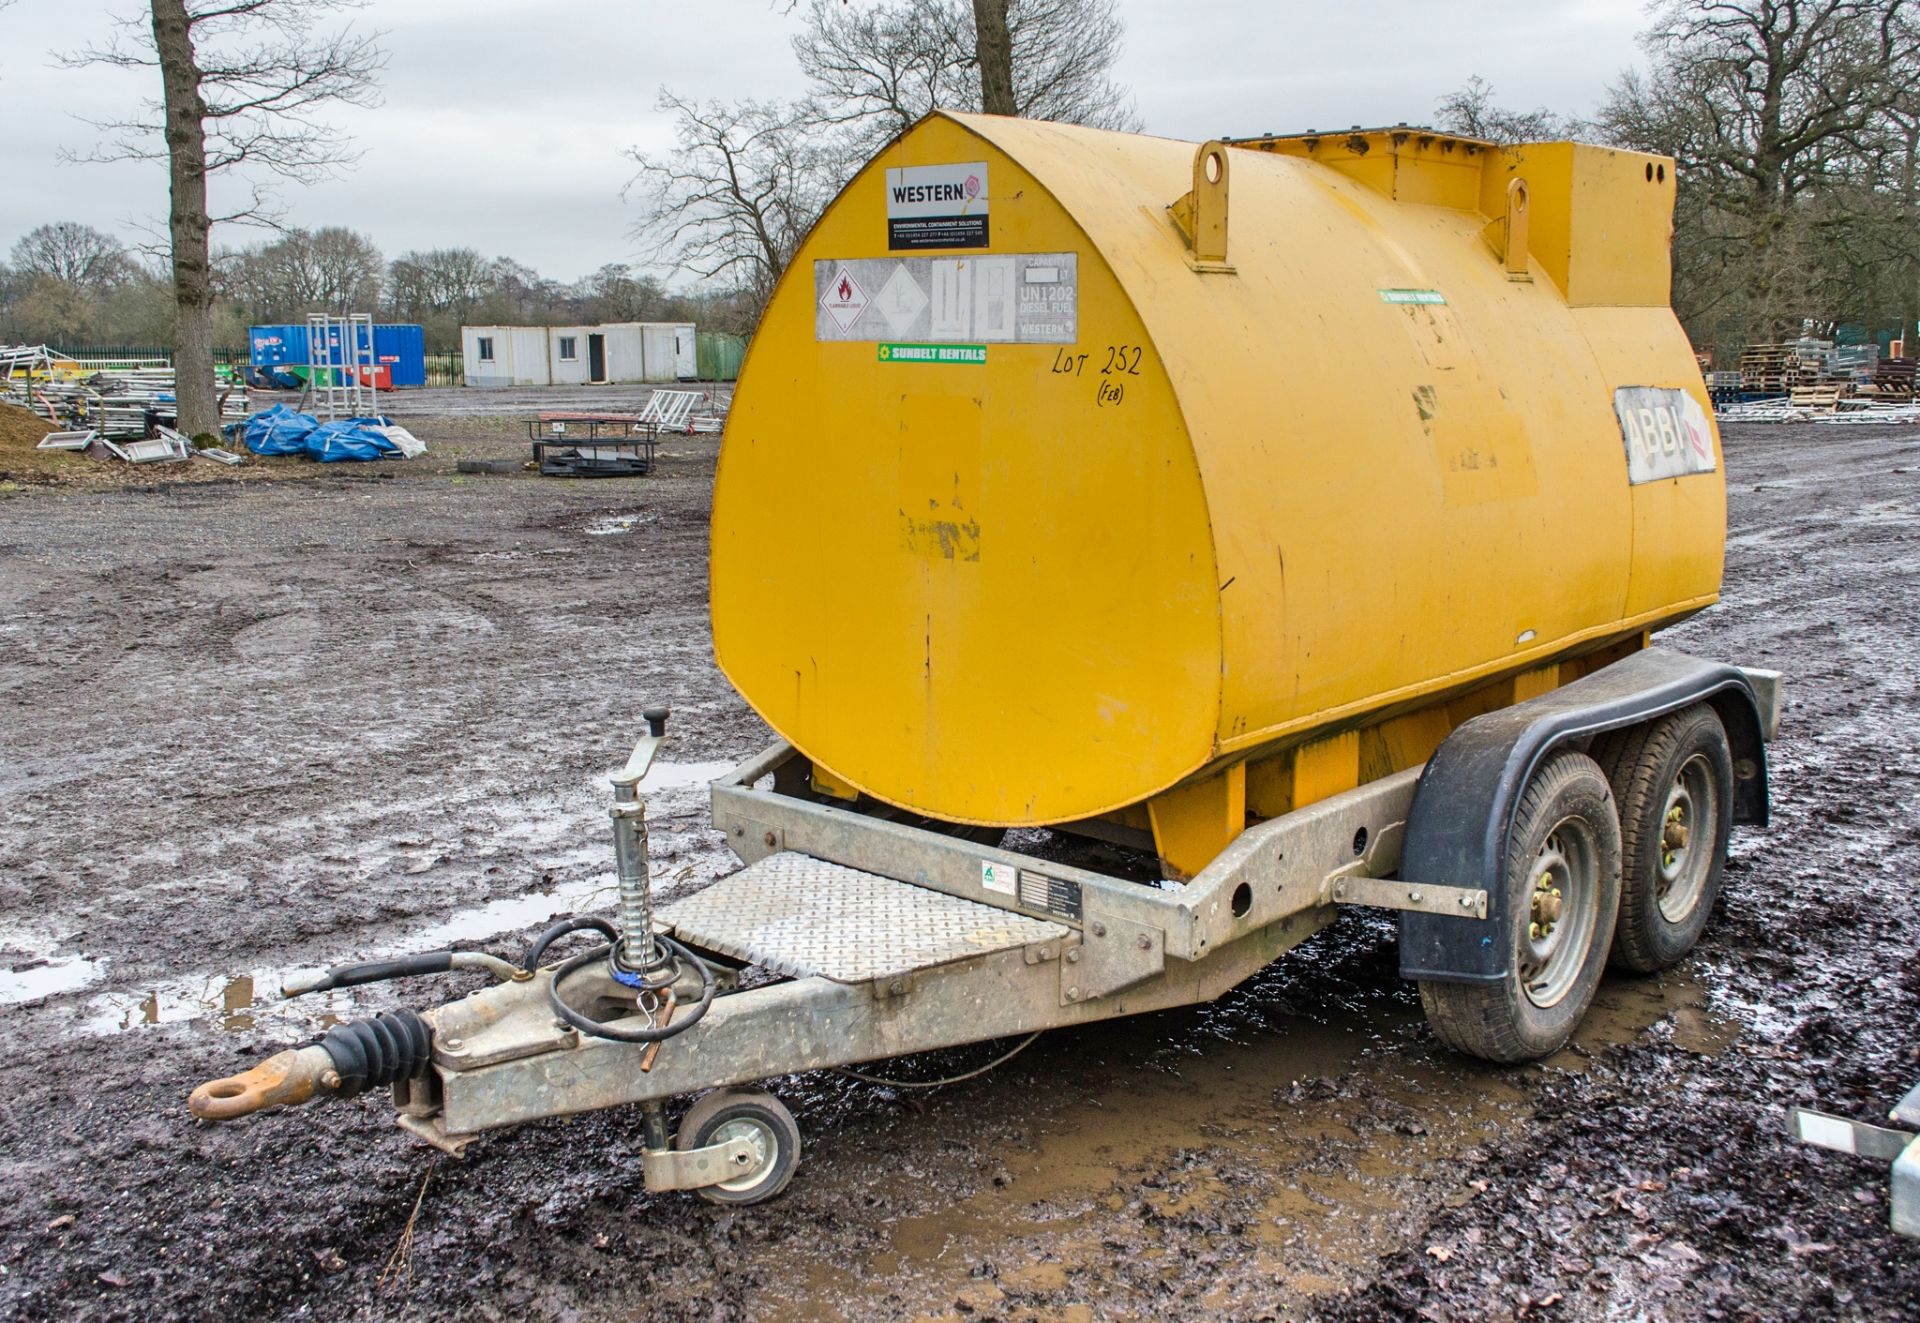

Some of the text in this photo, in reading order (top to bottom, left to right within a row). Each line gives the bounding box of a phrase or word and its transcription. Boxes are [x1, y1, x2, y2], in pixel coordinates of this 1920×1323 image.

[893, 184, 963, 203] WESTERN
[1028, 256, 1066, 267] CAPACITY
[1021, 286, 1074, 301] UN1202
[1021, 302, 1074, 313] DIESEL FUEL
[1021, 323, 1065, 335] WESTERN
[892, 347, 986, 361] SUNBELT RENTALS
[1052, 345, 1142, 377] LOT 252
